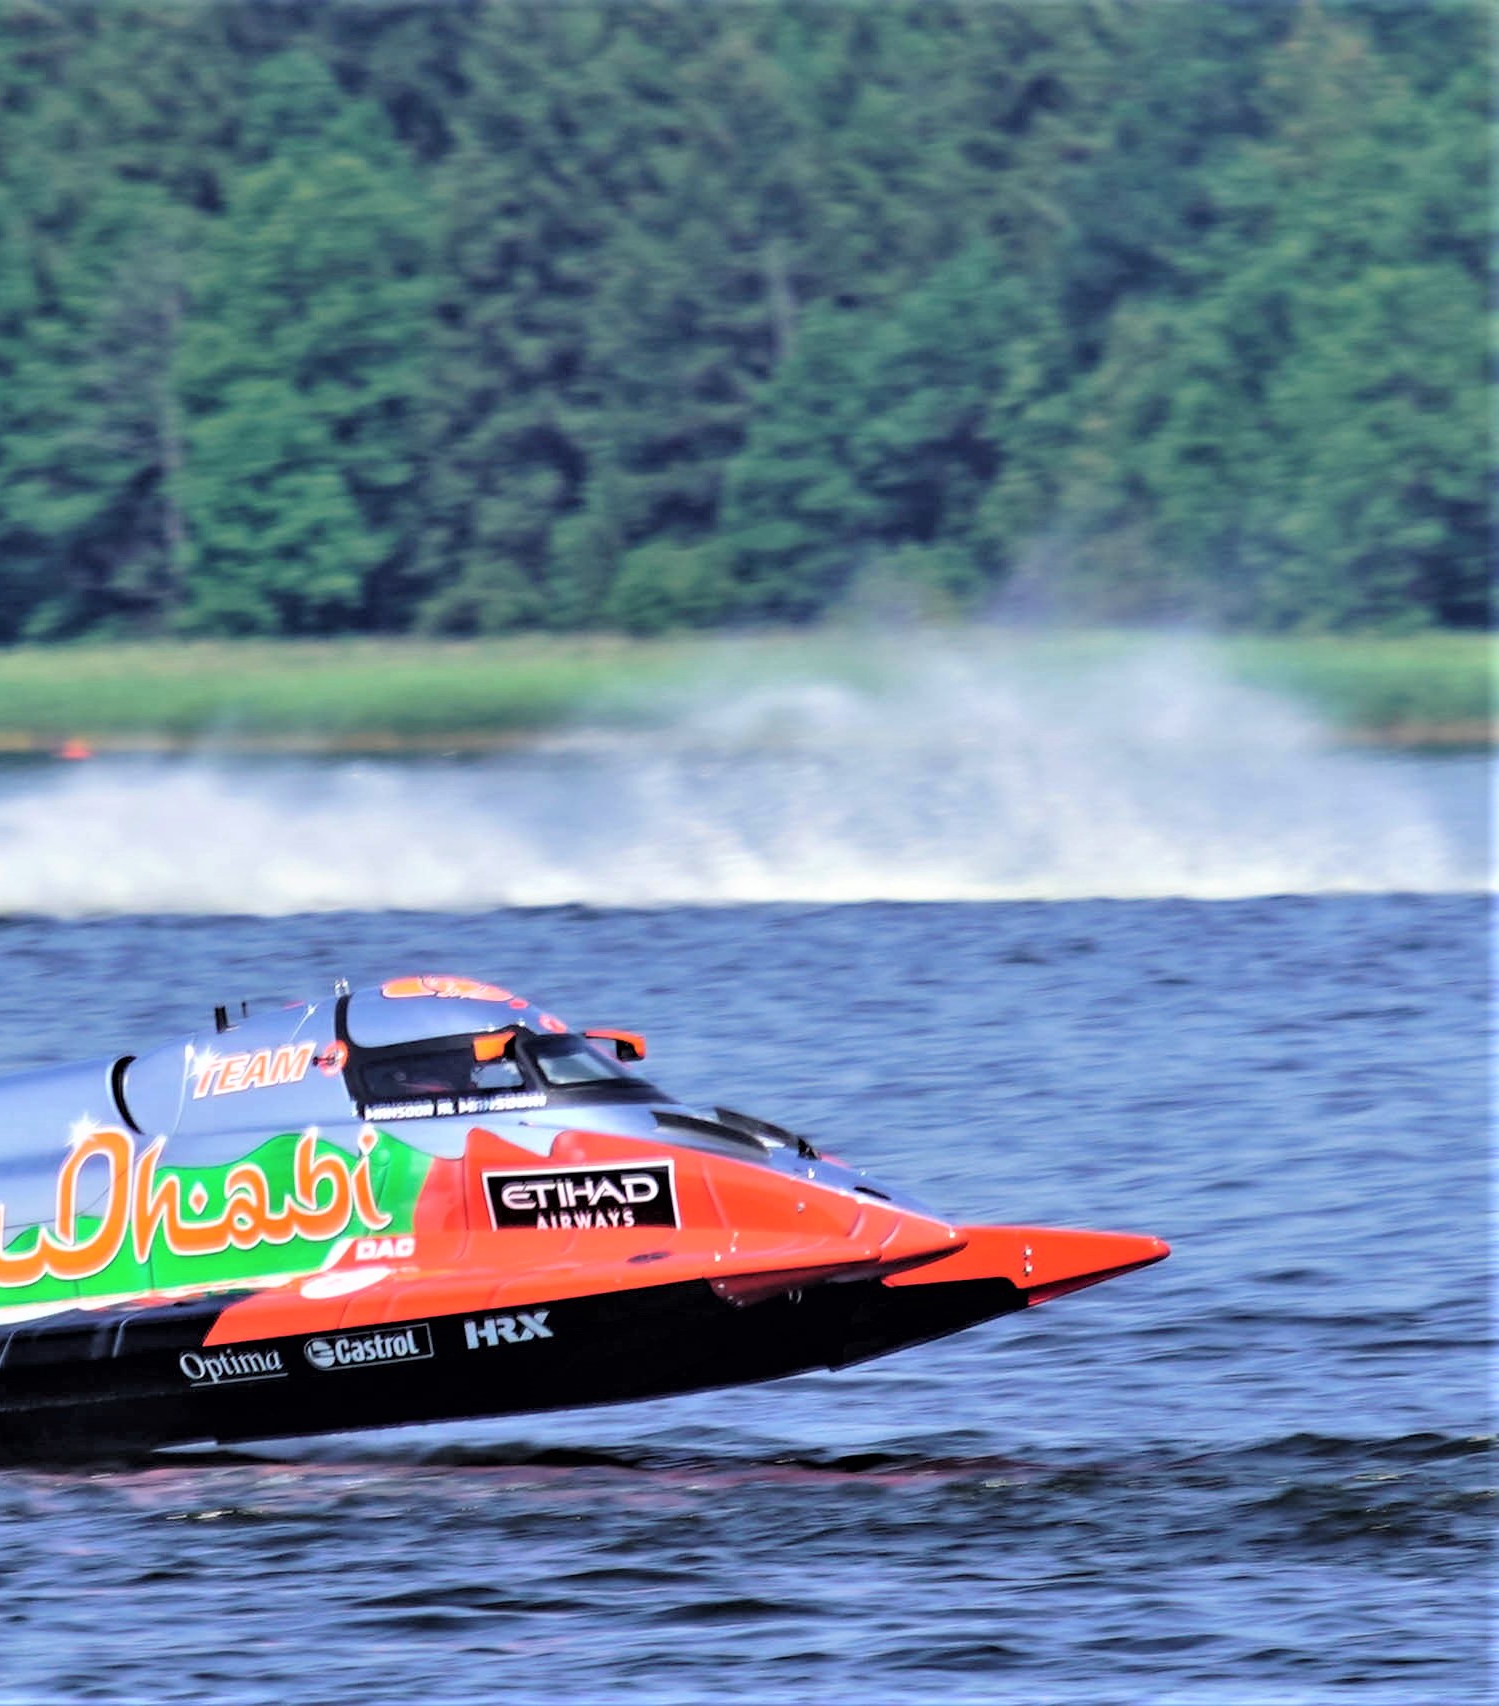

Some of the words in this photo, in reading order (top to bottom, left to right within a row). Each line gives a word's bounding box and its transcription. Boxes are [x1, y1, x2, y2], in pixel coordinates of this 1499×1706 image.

[193, 1040, 317, 1099] TEAM
[502, 1172, 660, 1210] ETIHAD
[536, 1207, 636, 1231] AIRWAYS
[335, 1329, 419, 1364] Castrol
[464, 1309, 554, 1350] HRX
[179, 1347, 283, 1383] Optima
